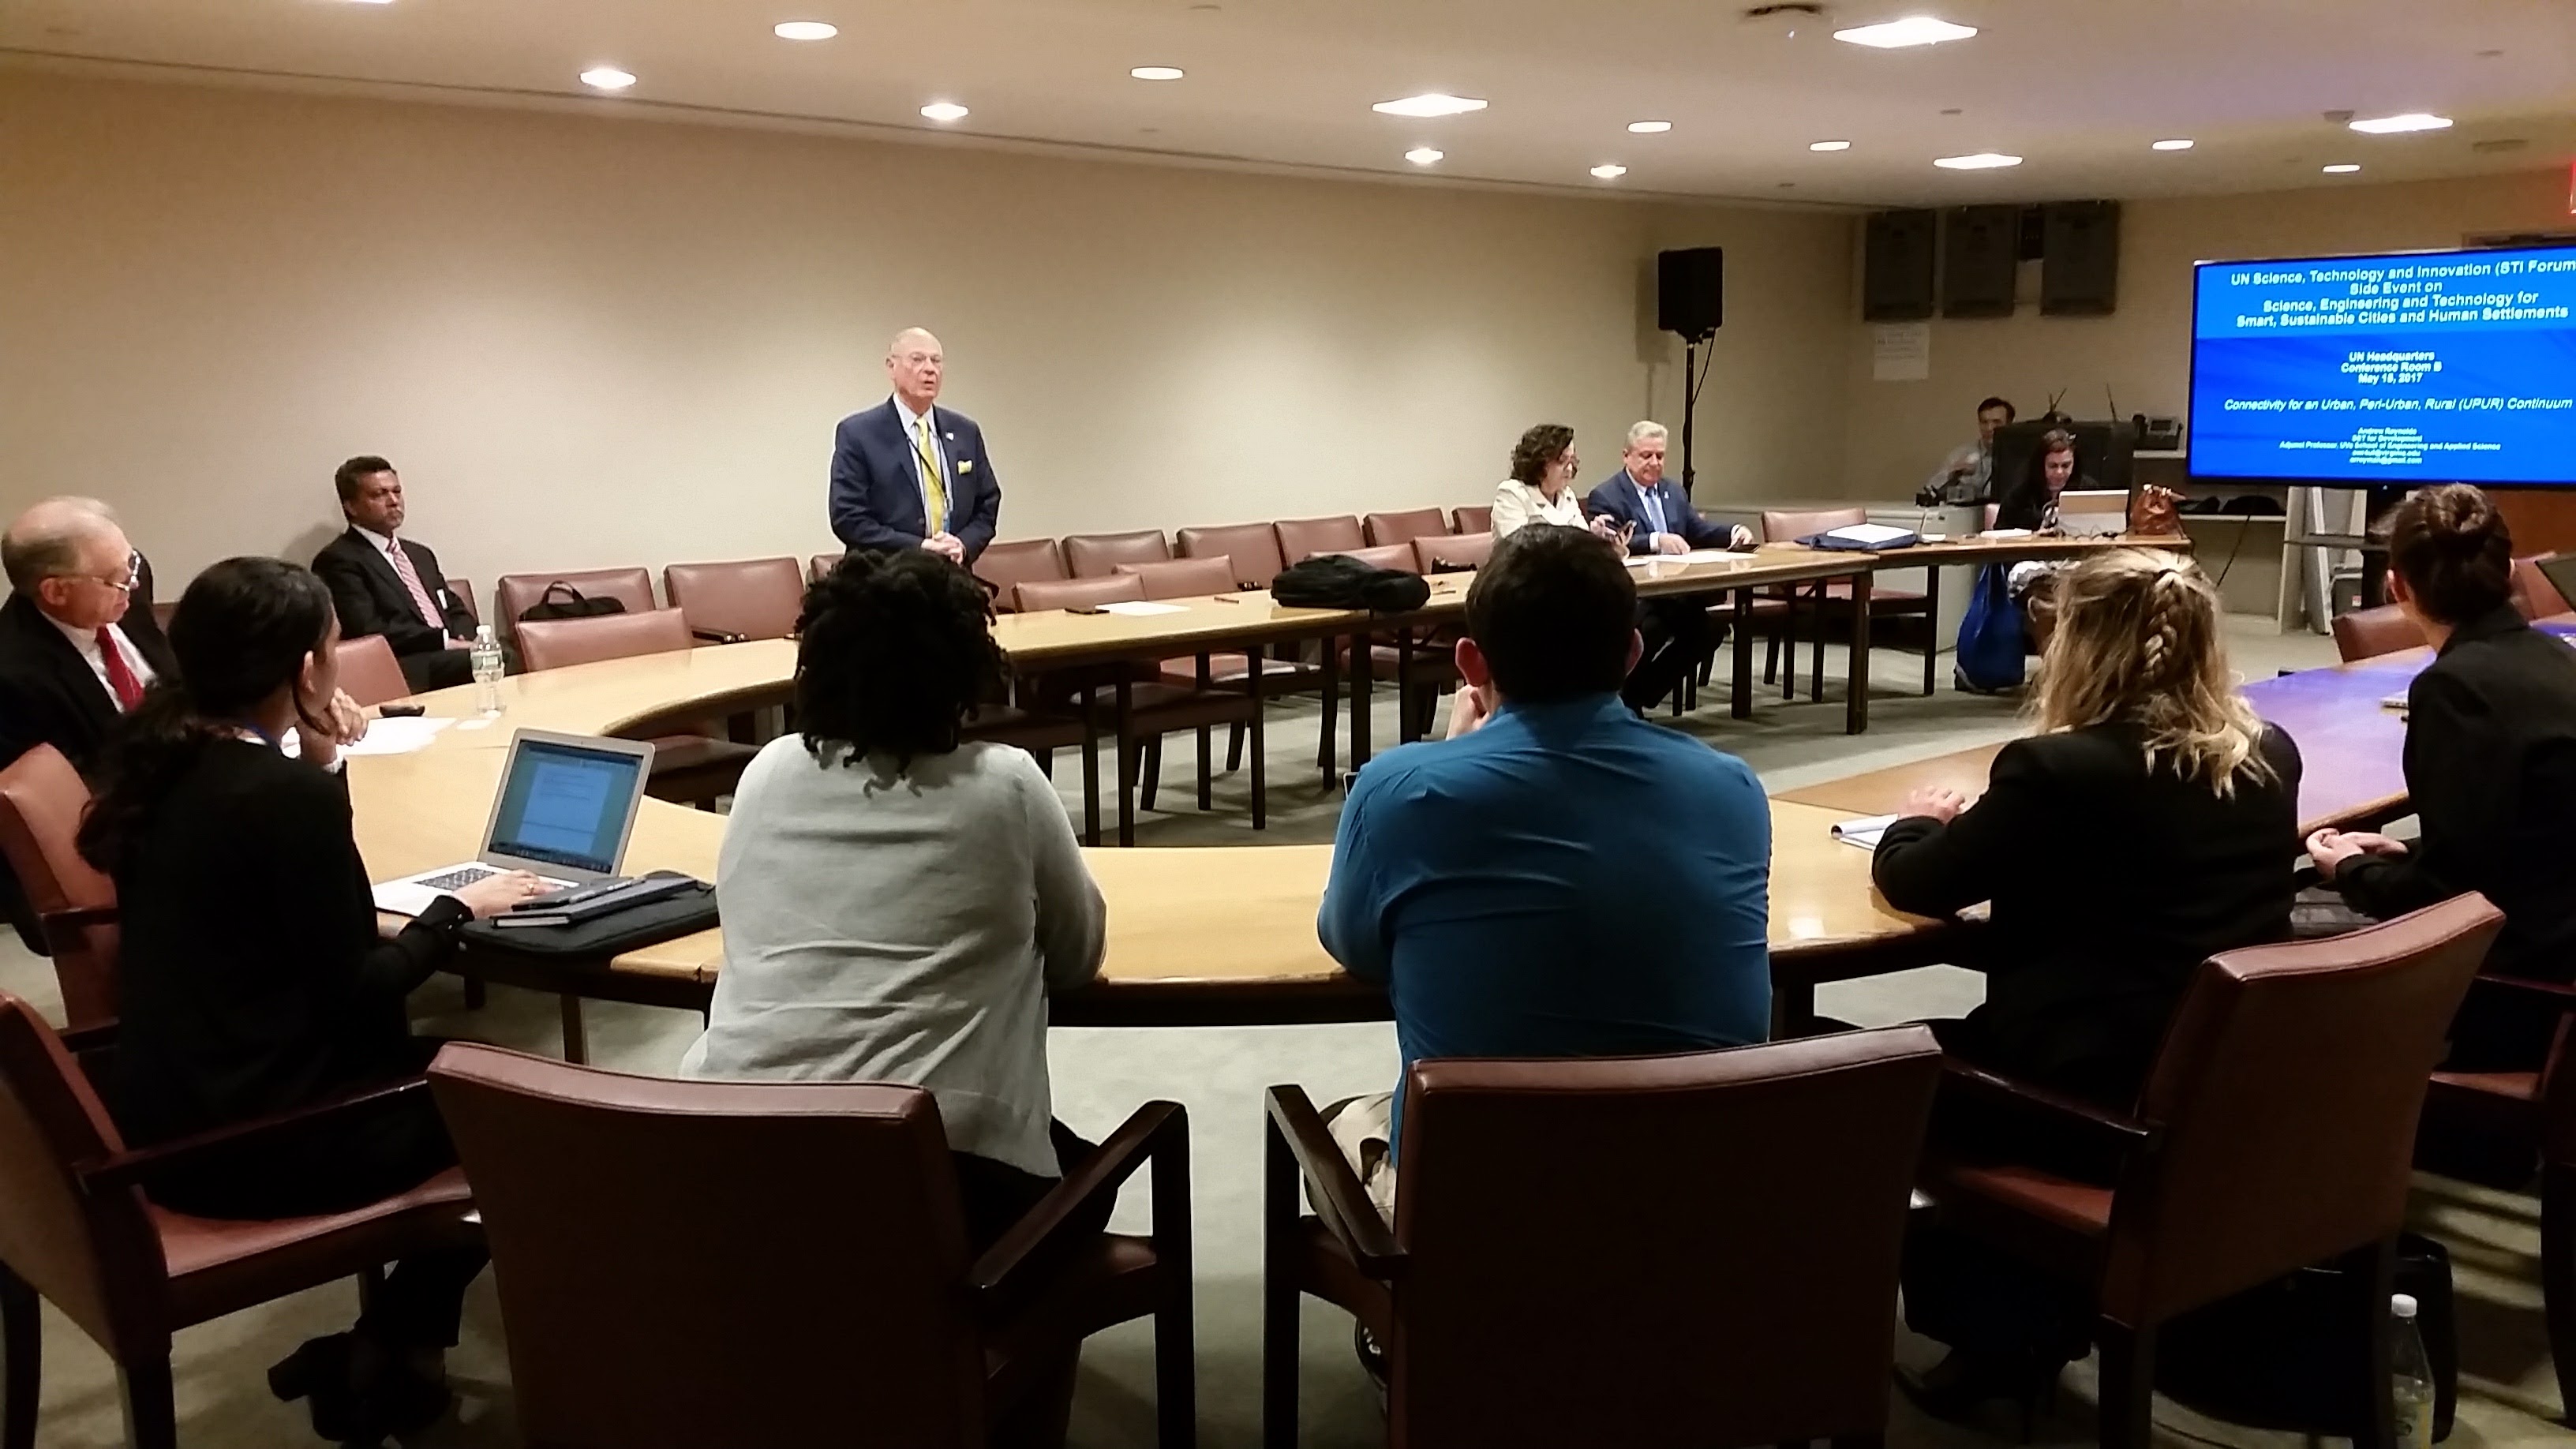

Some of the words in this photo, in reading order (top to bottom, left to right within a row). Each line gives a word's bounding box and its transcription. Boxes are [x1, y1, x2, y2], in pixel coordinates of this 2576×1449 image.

[2231, 273, 2250, 286] UN
[2253, 271, 2306, 286] Science,
[2309, 268, 2385, 283] Technology
[2388, 266, 2413, 279] and
[2417, 263, 2491, 278] Innovation
[2495, 260, 2524, 276] (STI
[2528, 260, 2576, 273] Forum
[2349, 283, 2379, 295] Side
[2383, 281, 2421, 294] Event
[2424, 281, 2443, 293] on
[2263, 299, 2316, 313] Science,
[2320, 296, 2399, 313] Engineering
[2402, 294, 2428, 308] and
[2432, 292, 2514, 308] Technology
[2518, 290, 2539, 304] for
[2237, 314, 2277, 328] Smart,
[2280, 312, 2355, 327] Sustainable
[2358, 311, 2396, 324] Cities
[2399, 309, 2424, 323] and
[2428, 309, 2478, 322] Human
[2482, 305, 2568, 320] Settlements
[2349, 351, 2364, 362] UN
[2366, 350, 2436, 363] Headquarters
[2341, 362, 2398, 373] Conference
[2401, 361, 2432, 372] Room
[2357, 373, 2379, 385] May
[2398, 372, 2424, 384] 2017
[2224, 399, 2287, 412] Connectivity
[2288, 399, 2305, 410] for
[2305, 400, 2319, 410] an
[2321, 399, 2357, 411] Urban,
[2359, 397, 2421, 411] Peri-Urban,
[2424, 398, 2457, 410] Rural
[2458, 397, 2504, 412] (UPUR)
[2507, 397, 2574, 410] Continuum
